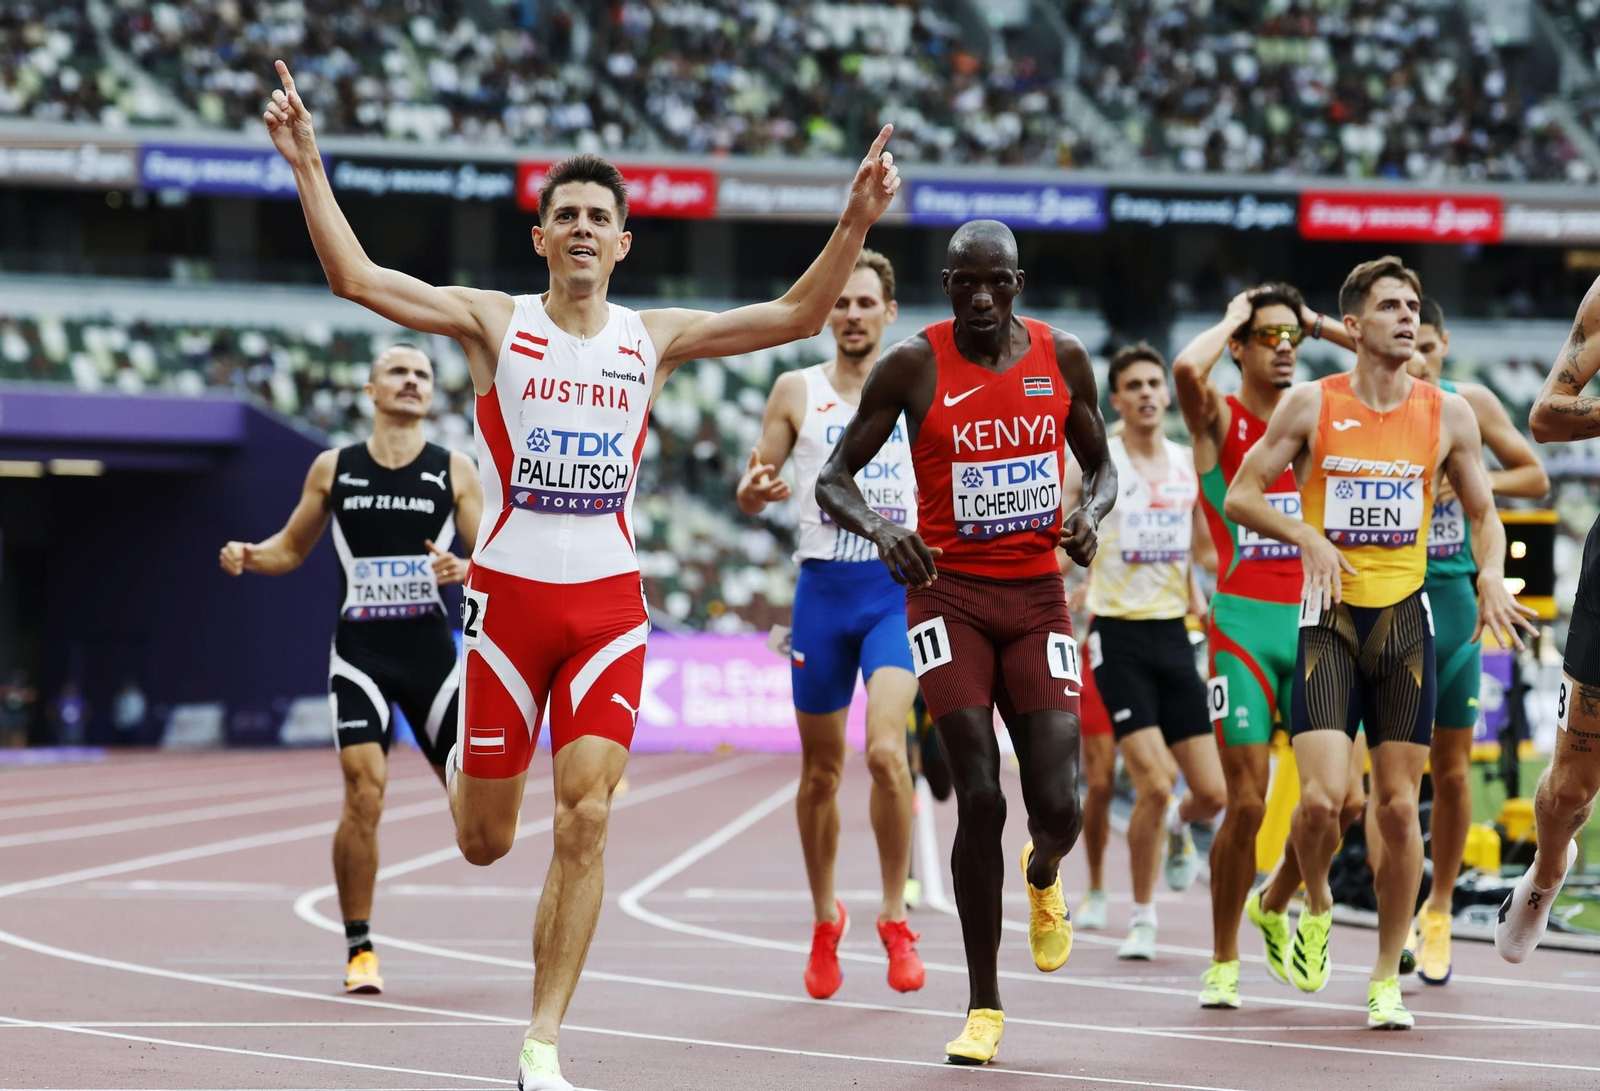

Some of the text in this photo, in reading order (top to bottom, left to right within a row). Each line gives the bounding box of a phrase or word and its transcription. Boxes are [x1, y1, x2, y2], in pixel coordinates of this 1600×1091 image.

[601, 368, 637, 382] helvetia
[522, 377, 628, 413] AUSTRIA
[552, 429, 624, 457] TDK
[952, 415, 1056, 454] KENYA
[518, 458, 628, 490] PALLITSCH
[864, 463, 901, 480] DK
[983, 457, 1052, 487] TDK
[1321, 455, 1425, 479] ESPAÑA
[1354, 481, 1415, 500] TDK
[343, 495, 435, 514] NEW ZEALAND
[541, 496, 604, 510] TOKYO
[958, 483, 1057, 518] T. CHERUIYOT
[1350, 507, 1401, 526] BEN
[984, 517, 1041, 536] TOKYO
[1349, 532, 1401, 545] TOKYO
[1262, 545, 1299, 557] TOKY
[371, 559, 428, 578] TDK
[354, 581, 432, 601] TANNER
[914, 627, 941, 665] 11
[1055, 641, 1078, 676] 11
